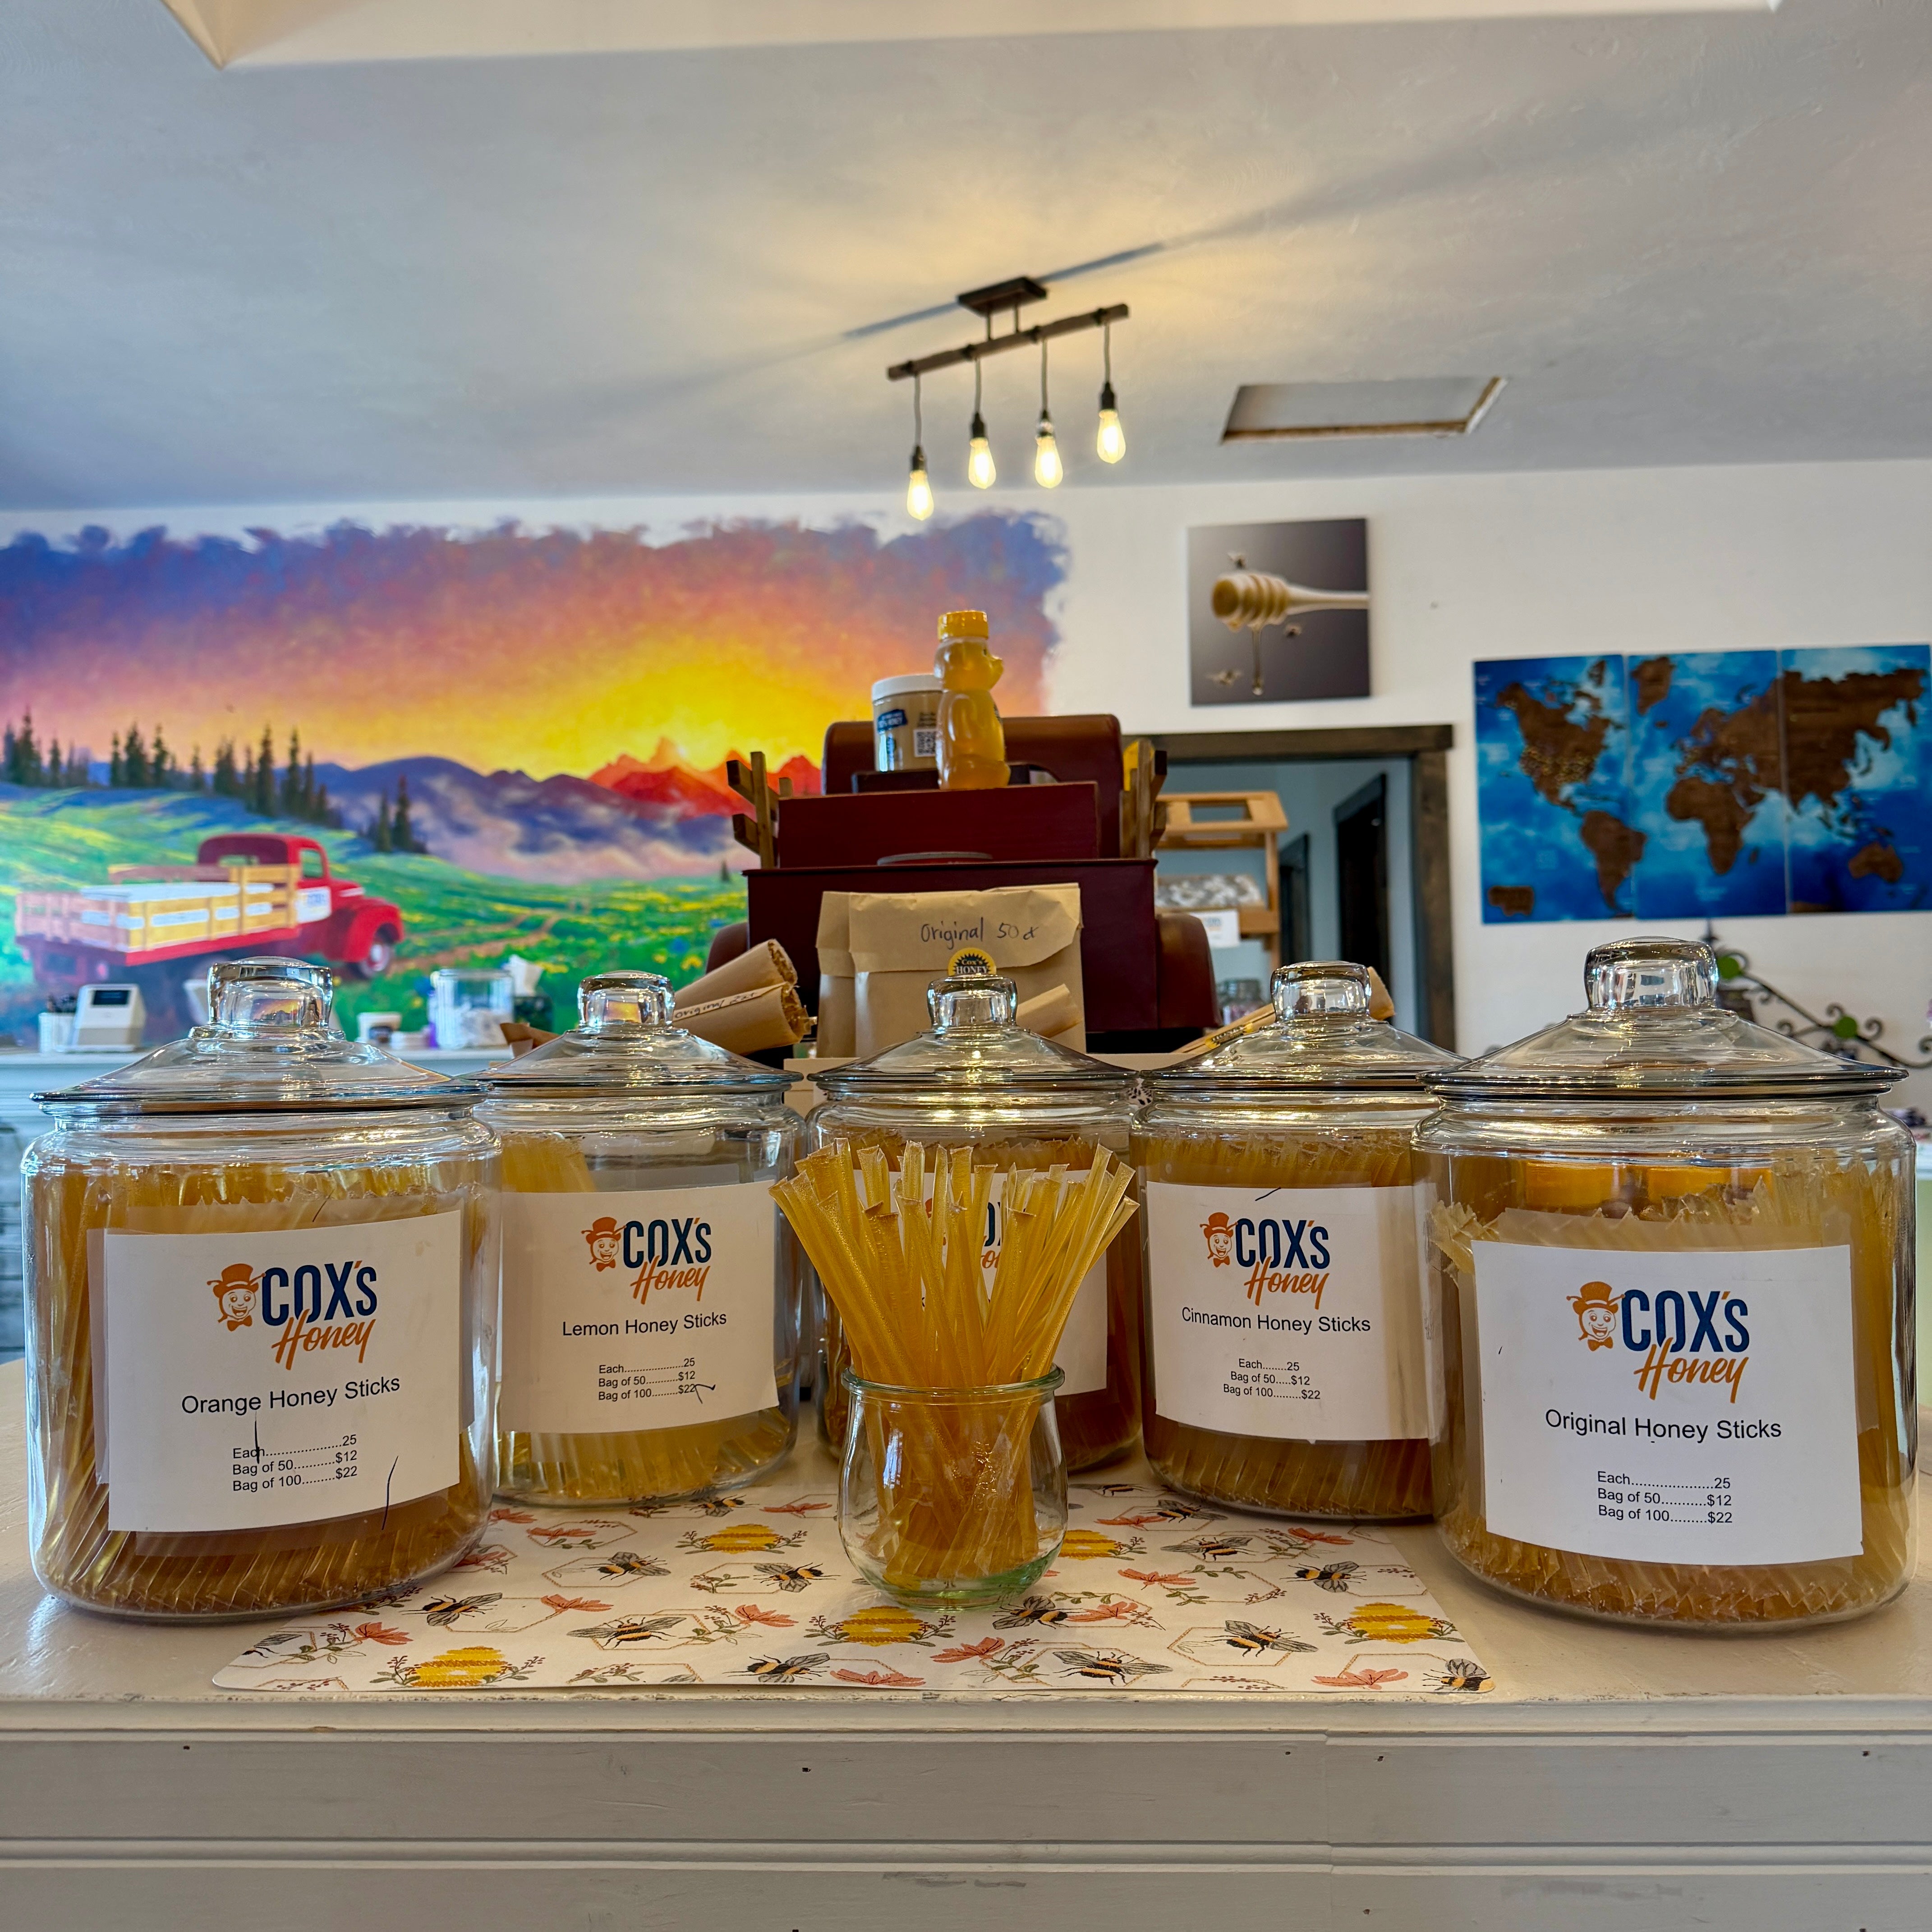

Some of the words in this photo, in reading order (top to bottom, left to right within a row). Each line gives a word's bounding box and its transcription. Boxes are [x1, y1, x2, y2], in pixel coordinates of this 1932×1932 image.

[921, 916, 984, 950] Original
[956, 966, 988, 975] HONEY
[630, 1256, 711, 1305] Honey
[1244, 1256, 1329, 1310] Honey
[563, 1321, 619, 1336] Lemon
[626, 1318, 678, 1334] Honey
[684, 1312, 727, 1329] Sticks
[1182, 1306, 1251, 1329] Cinnamon
[1257, 1314, 1312, 1335] Honey
[1319, 1316, 1371, 1332] Sticks
[272, 1309, 376, 1371] Honey
[1231, 1371, 1249, 1384] Bag
[1251, 1373, 1261, 1384] of
[1633, 1337, 1749, 1403] Honey
[598, 1378, 618, 1389] Bag
[621, 1376, 631, 1386] of
[1223, 1383, 1241, 1397] Bag
[1243, 1386, 1253, 1396] of
[182, 1395, 261, 1416] Orange
[270, 1389, 337, 1409] Honey
[345, 1376, 400, 1399] Sticks
[598, 1391, 618, 1402] Bag
[621, 1389, 631, 1399] of
[1546, 1409, 1626, 1436] Original
[1635, 1418, 1708, 1444] Honey
[1717, 1419, 1781, 1439] Sticks
[232, 1464, 258, 1477] Bag
[262, 1461, 275, 1473] of
[232, 1480, 258, 1493] Bag
[262, 1477, 275, 1489] of
[1598, 1487, 1623, 1504] Bag
[1627, 1491, 1641, 1503] of
[1598, 1504, 1624, 1521] Bag
[1628, 1508, 1641, 1519] of
